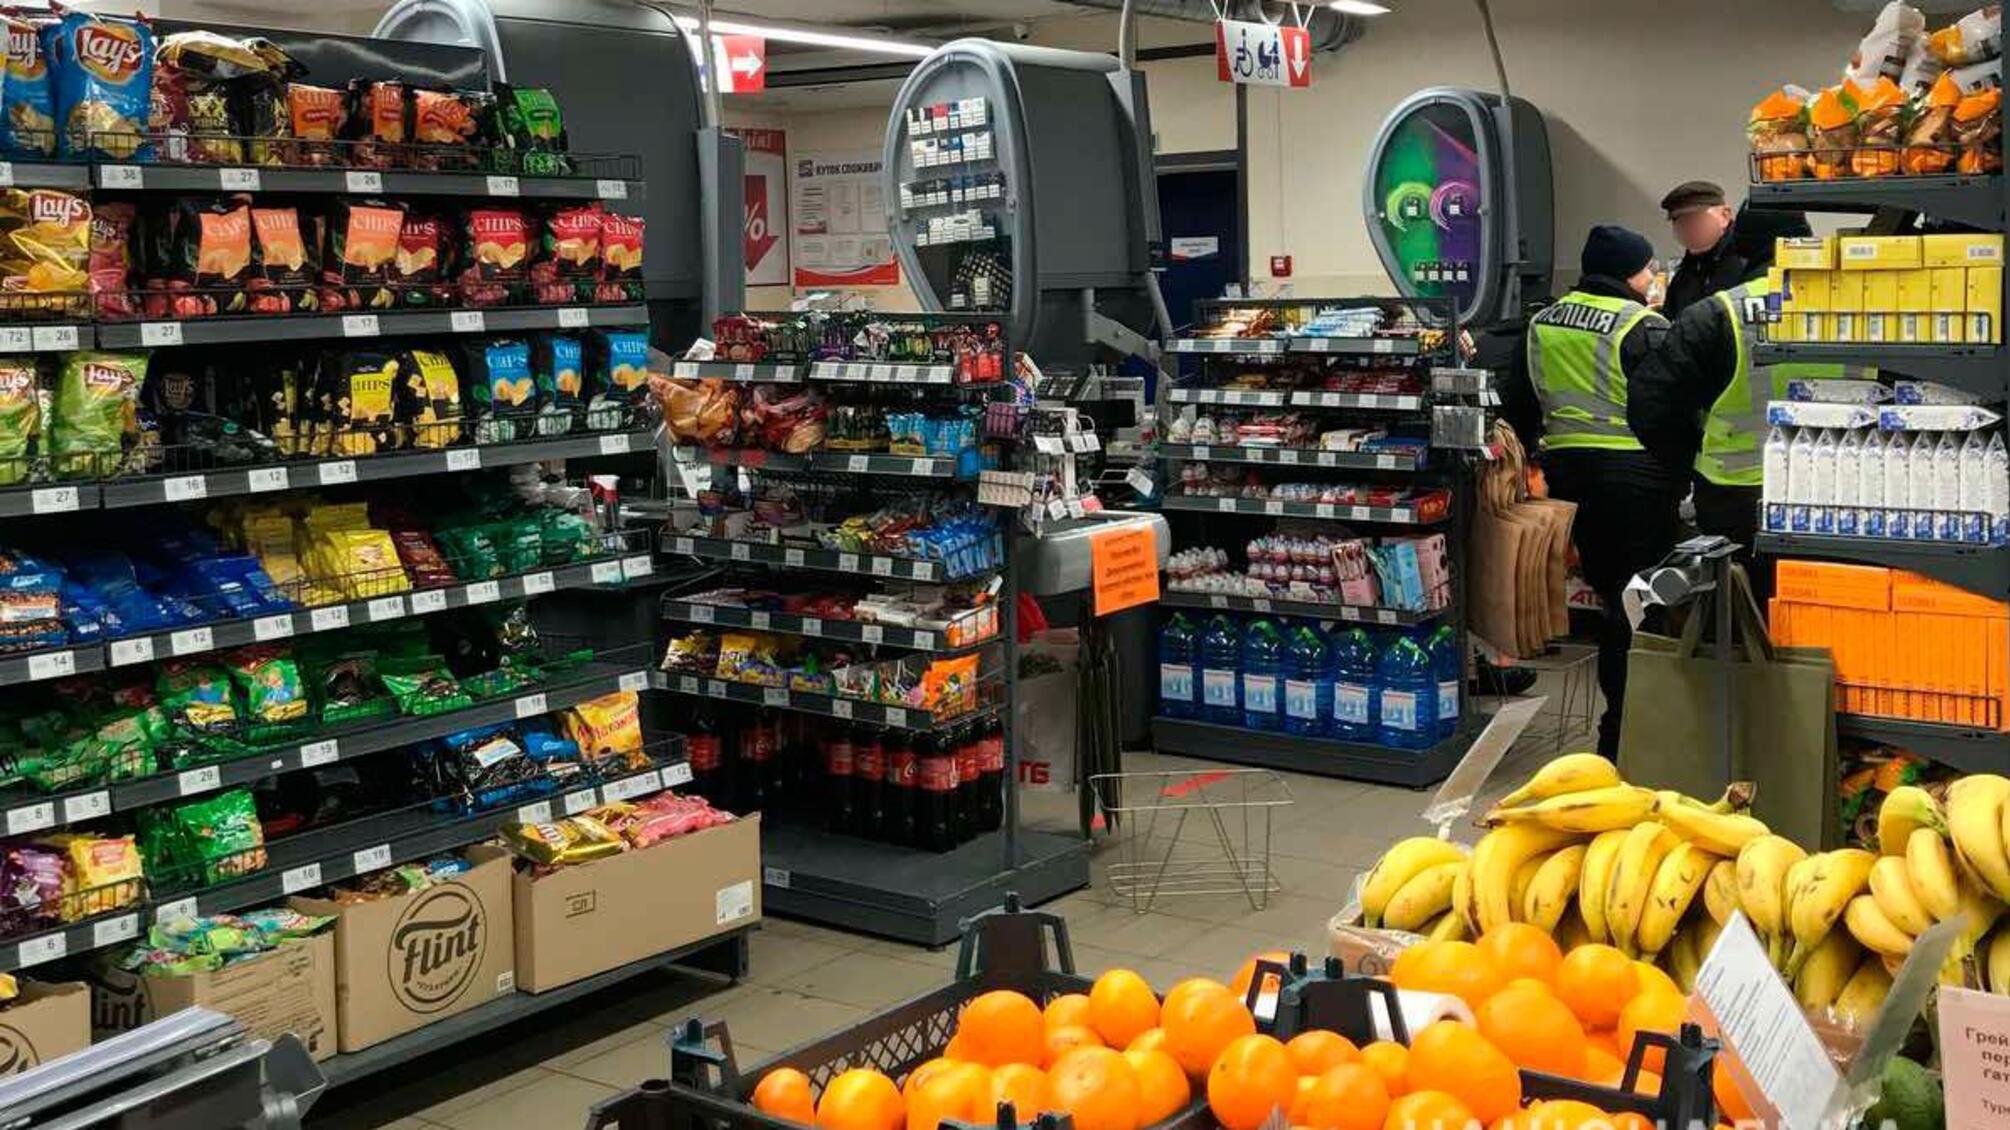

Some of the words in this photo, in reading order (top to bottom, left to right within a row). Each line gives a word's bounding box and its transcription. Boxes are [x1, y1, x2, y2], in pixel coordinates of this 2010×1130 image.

[241, 171, 252, 182] 27
[353, 213, 400, 231] CHIPS
[477, 217, 522, 232] CHIPS
[559, 213, 601, 229] CHIPS
[9, 331, 23, 343] 72
[56, 330, 71, 341] 26
[161, 326, 174, 337] 27
[269, 471, 281, 482] 12
[185, 480, 199, 490] 16
[55, 491, 70, 502] 27
[193, 631, 206, 643] 12
[53, 656, 67, 668] 14
[91, 797, 99, 808] 5
[120, 918, 128, 930] 6
[48, 939, 55, 951] 6
